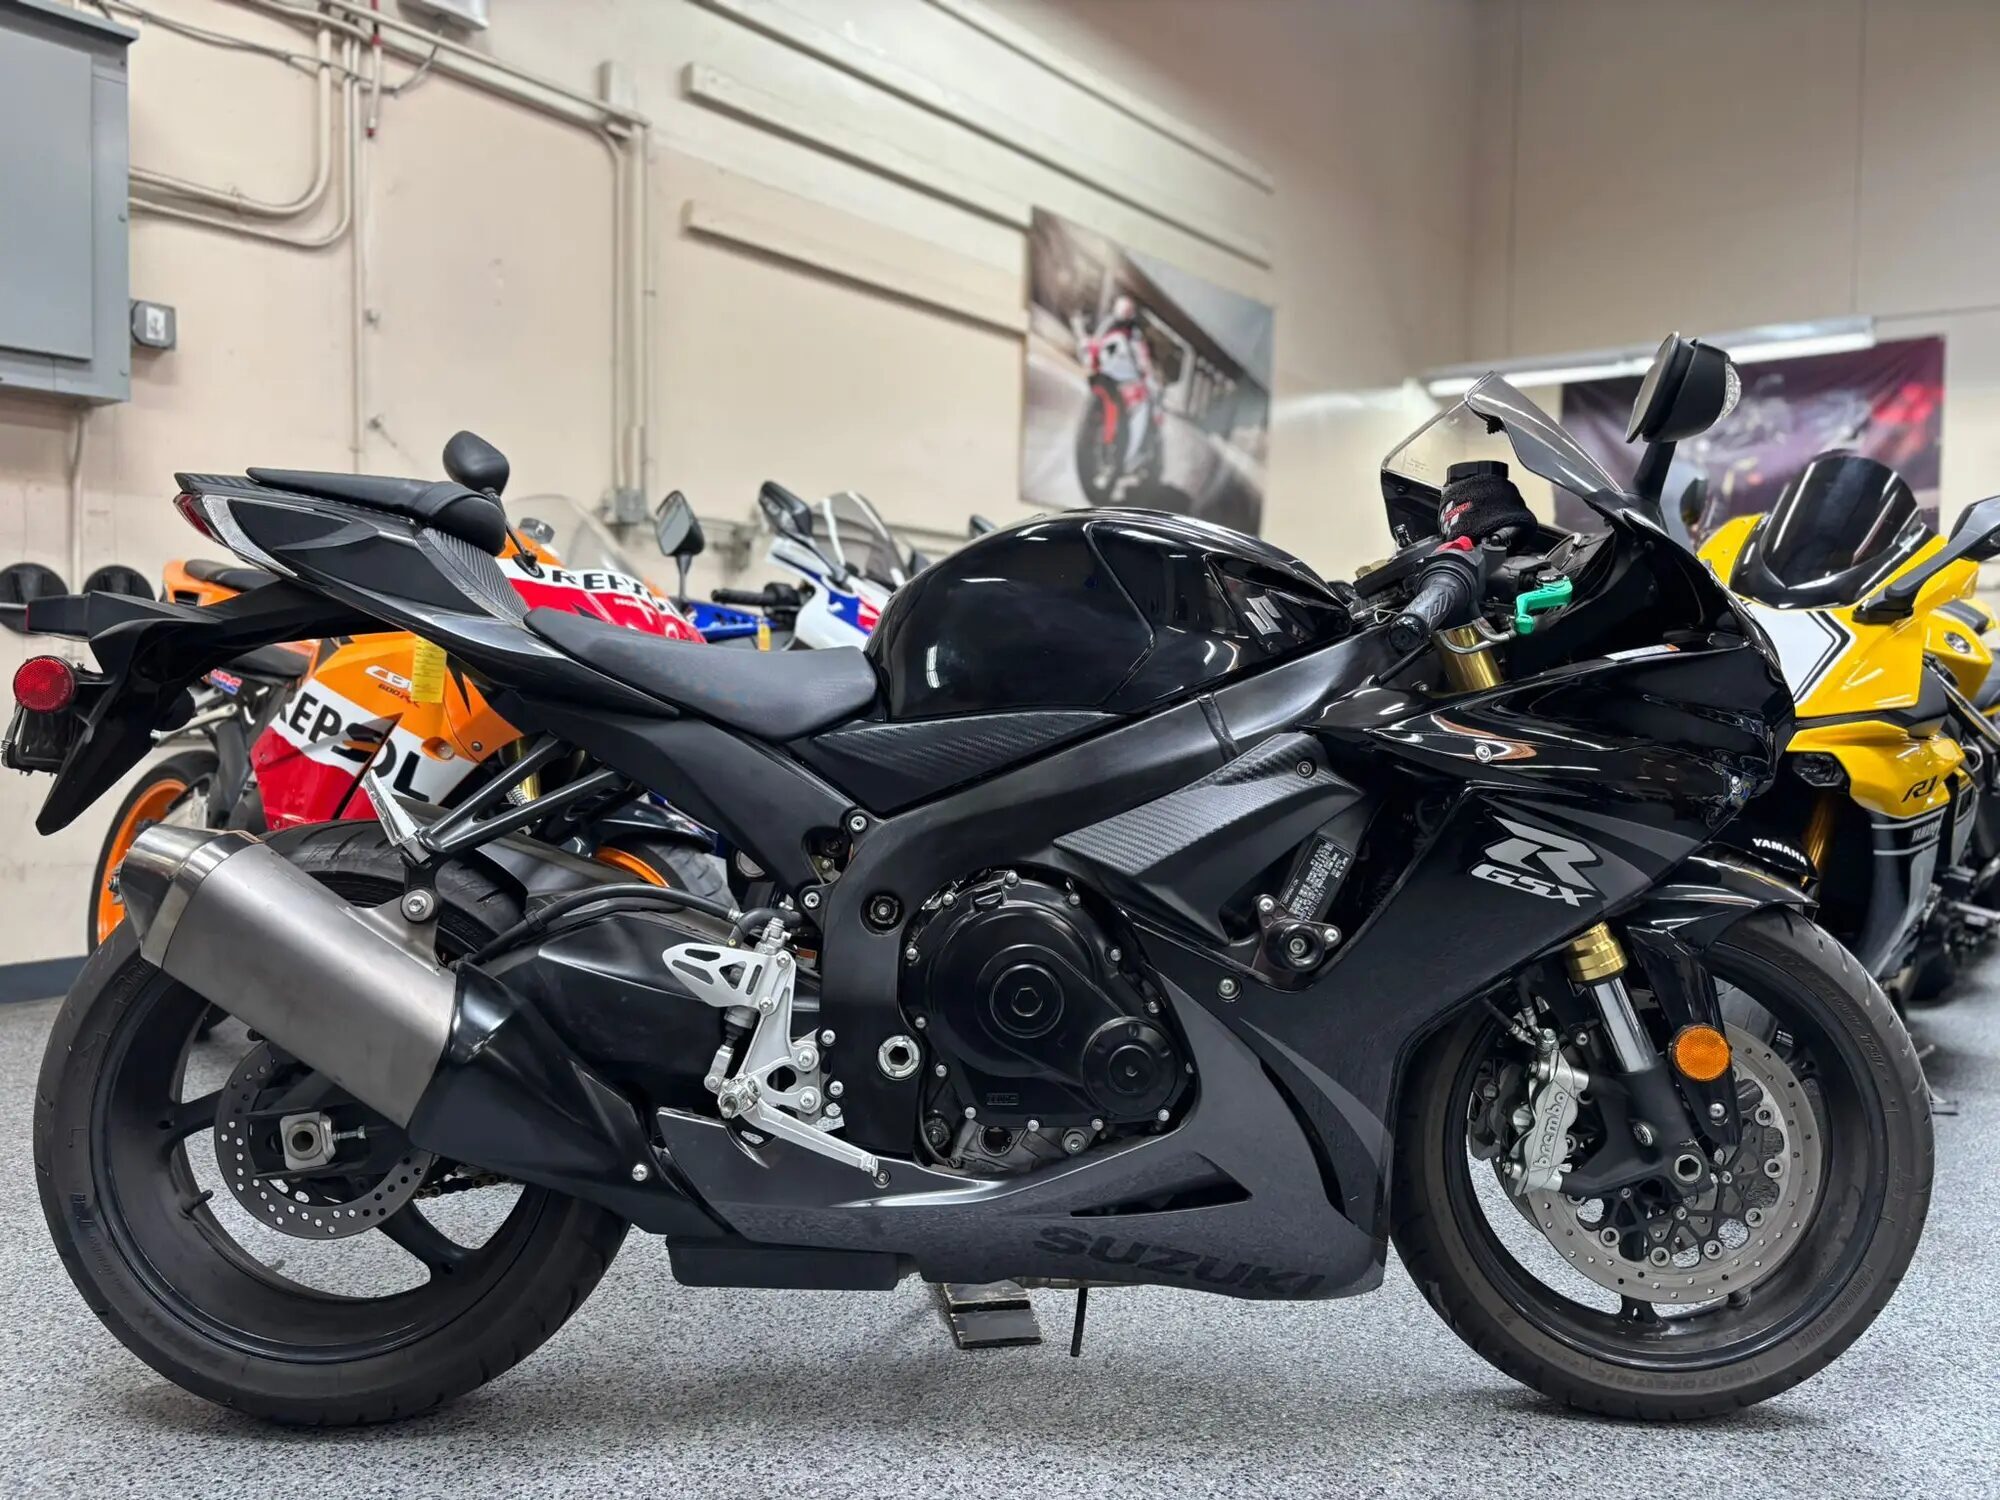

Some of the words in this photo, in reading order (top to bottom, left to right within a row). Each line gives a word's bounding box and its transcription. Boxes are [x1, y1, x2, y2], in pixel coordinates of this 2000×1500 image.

[1752, 837, 1808, 867] YAMAHA
[1471, 863, 1596, 907] GSX
[1533, 1091, 1566, 1168] brembo
[1033, 1226, 1326, 1296] SUZUKI
